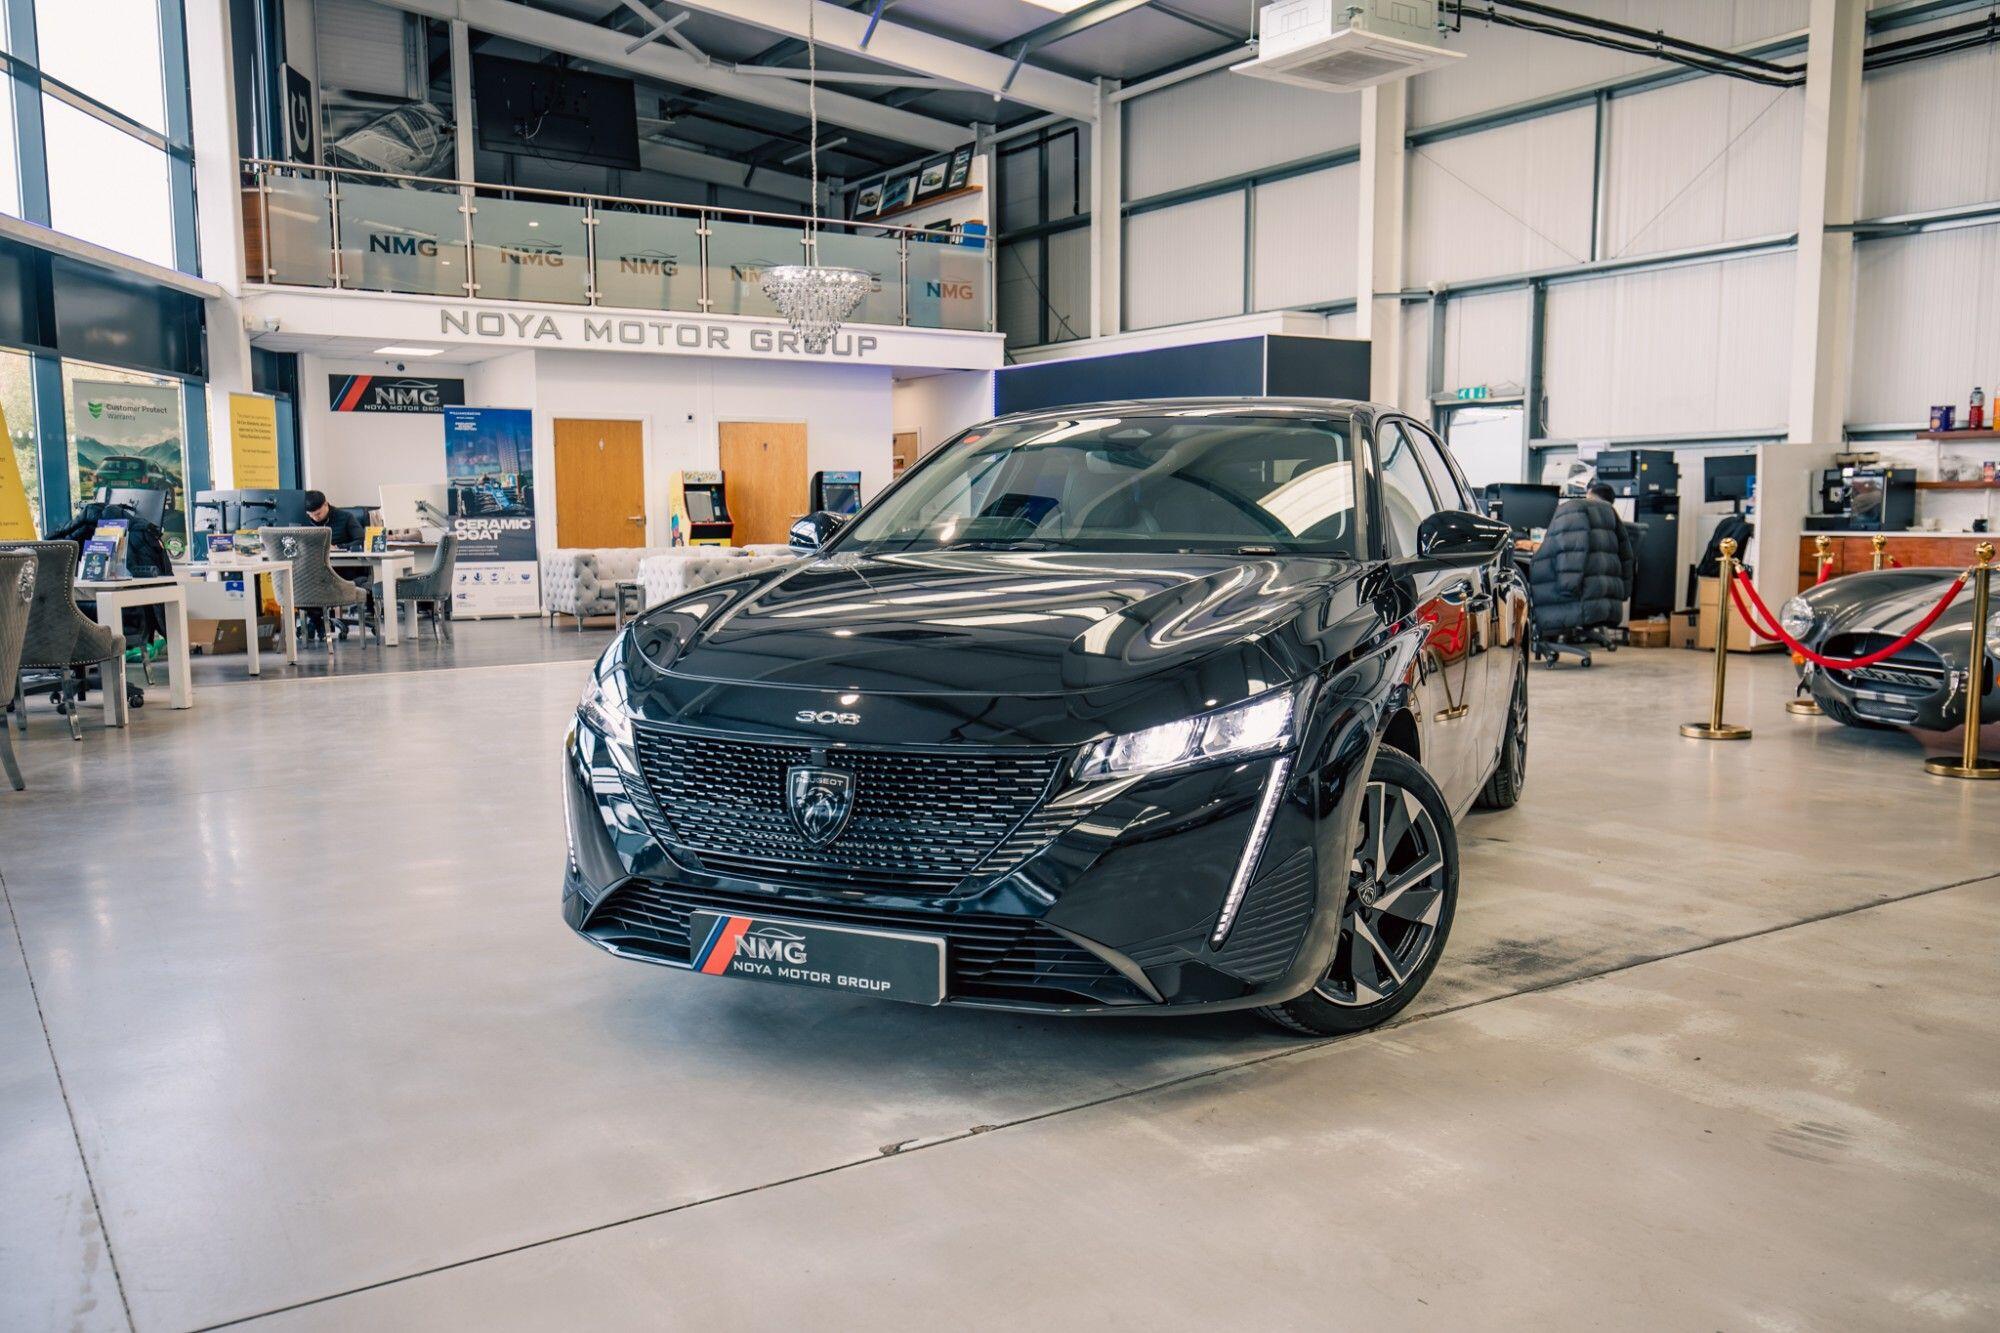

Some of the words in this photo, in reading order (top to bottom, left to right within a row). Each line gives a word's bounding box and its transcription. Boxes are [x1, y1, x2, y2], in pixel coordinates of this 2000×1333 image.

[370, 234, 438, 257] NMG
[501, 245, 563, 267] NMG
[620, 256, 678, 277] NMG
[926, 281, 974, 299] NMG
[441, 309, 563, 340] NOYA
[584, 318, 729, 350] MOTOR
[375, 387, 440, 405] NMG
[106, 403, 140, 412] Customer
[142, 405, 167, 414] Protect
[107, 413, 135, 421] Warranty
[454, 519, 531, 530] CERAMIC
[455, 529, 501, 541] COAT
[796, 710, 860, 726] 308
[734, 935, 807, 965] NMG
[733, 962, 772, 976] NOYA
[778, 967, 830, 984] MOTOR
[837, 975, 891, 992] GROUP
